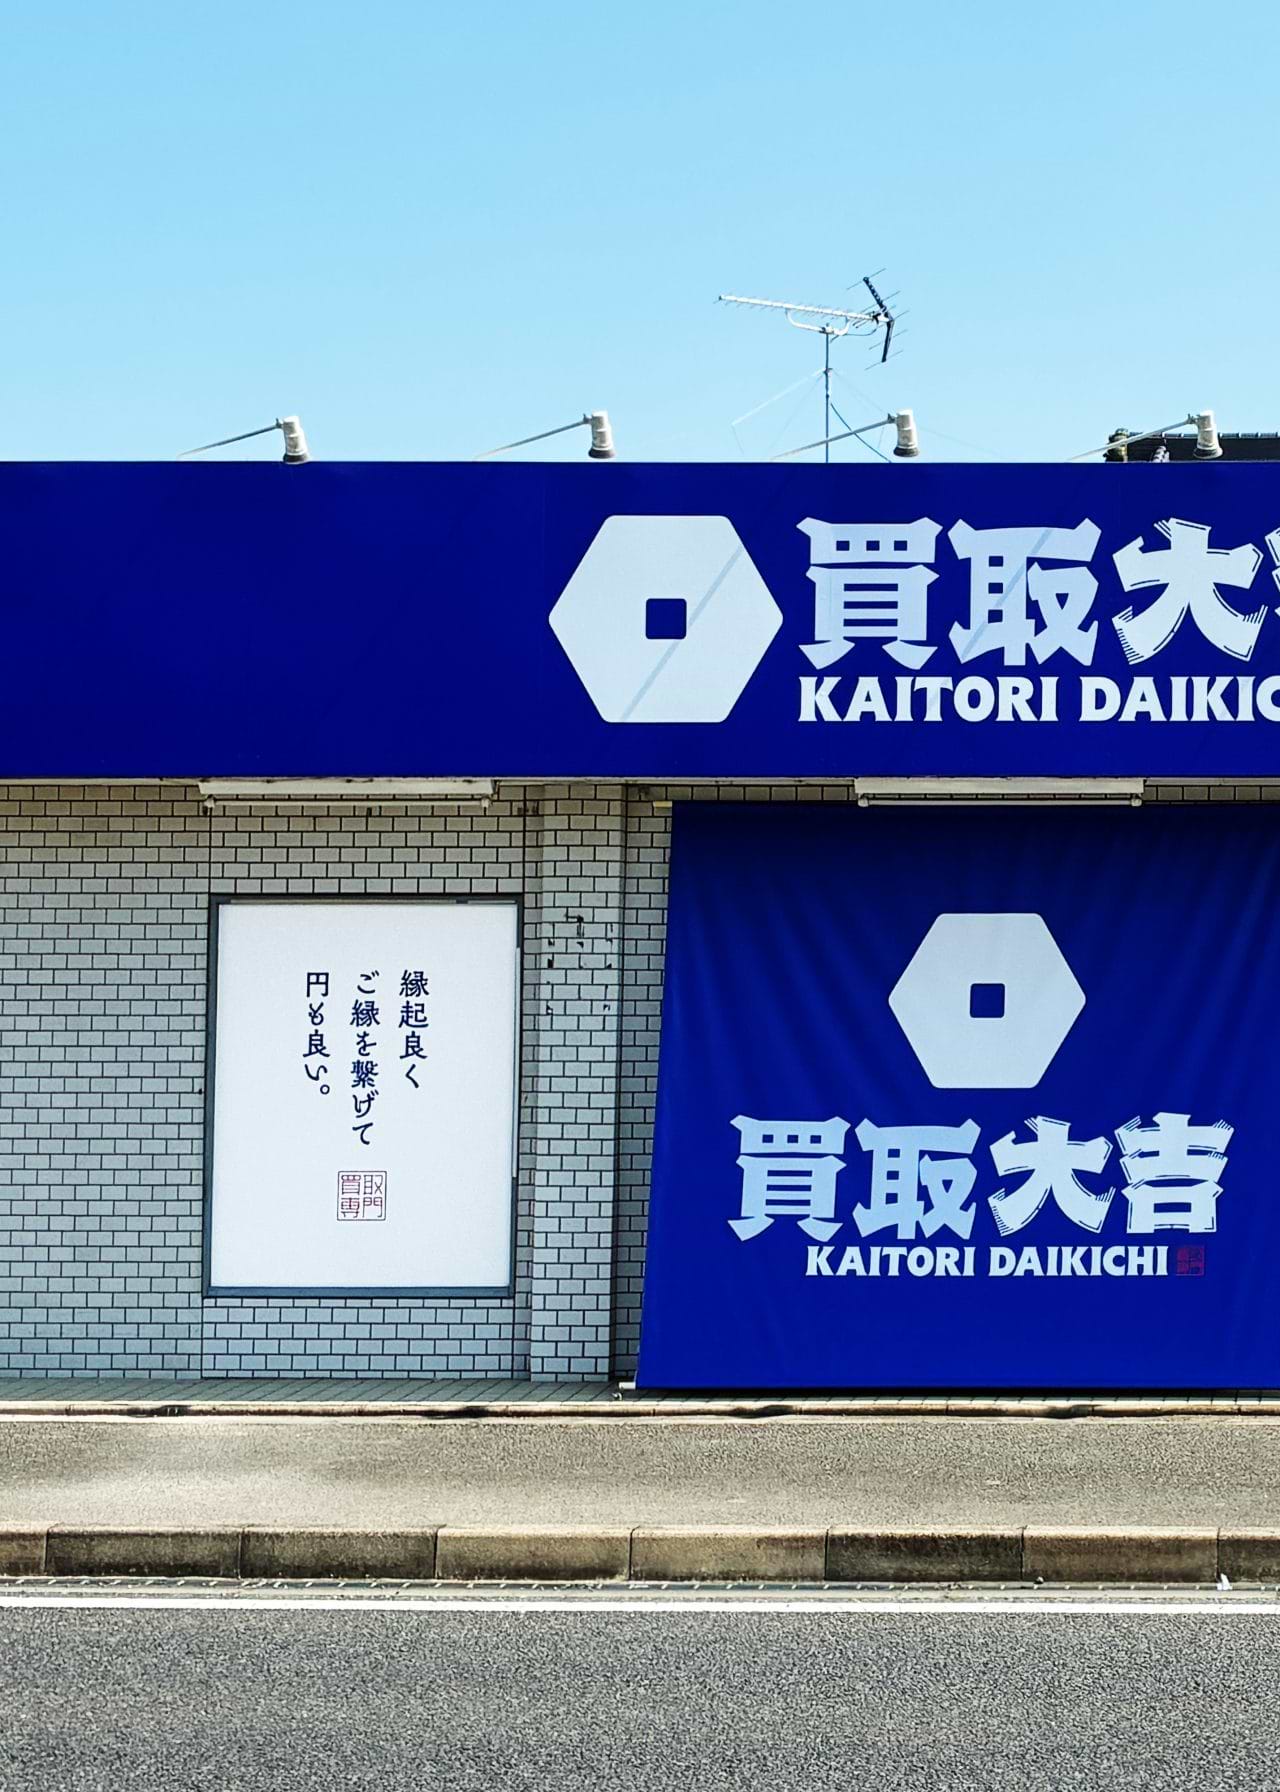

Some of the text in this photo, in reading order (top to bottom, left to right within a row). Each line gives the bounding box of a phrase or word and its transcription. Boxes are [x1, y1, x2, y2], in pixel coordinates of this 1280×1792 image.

[798, 676, 1059, 722] KAITORI
[303, 972, 330, 1094] 円も良い。
[350, 970, 380, 1145] ご縁を繋げて
[399, 970, 429, 1088] 縁起良く
[341, 1175, 382, 1195] 買取
[341, 1198, 383, 1218] 専門
[728, 1112, 1234, 1242] 買取大吉
[806, 1246, 976, 1276] KAITORI
[989, 1246, 1168, 1276] DAIKICHI
